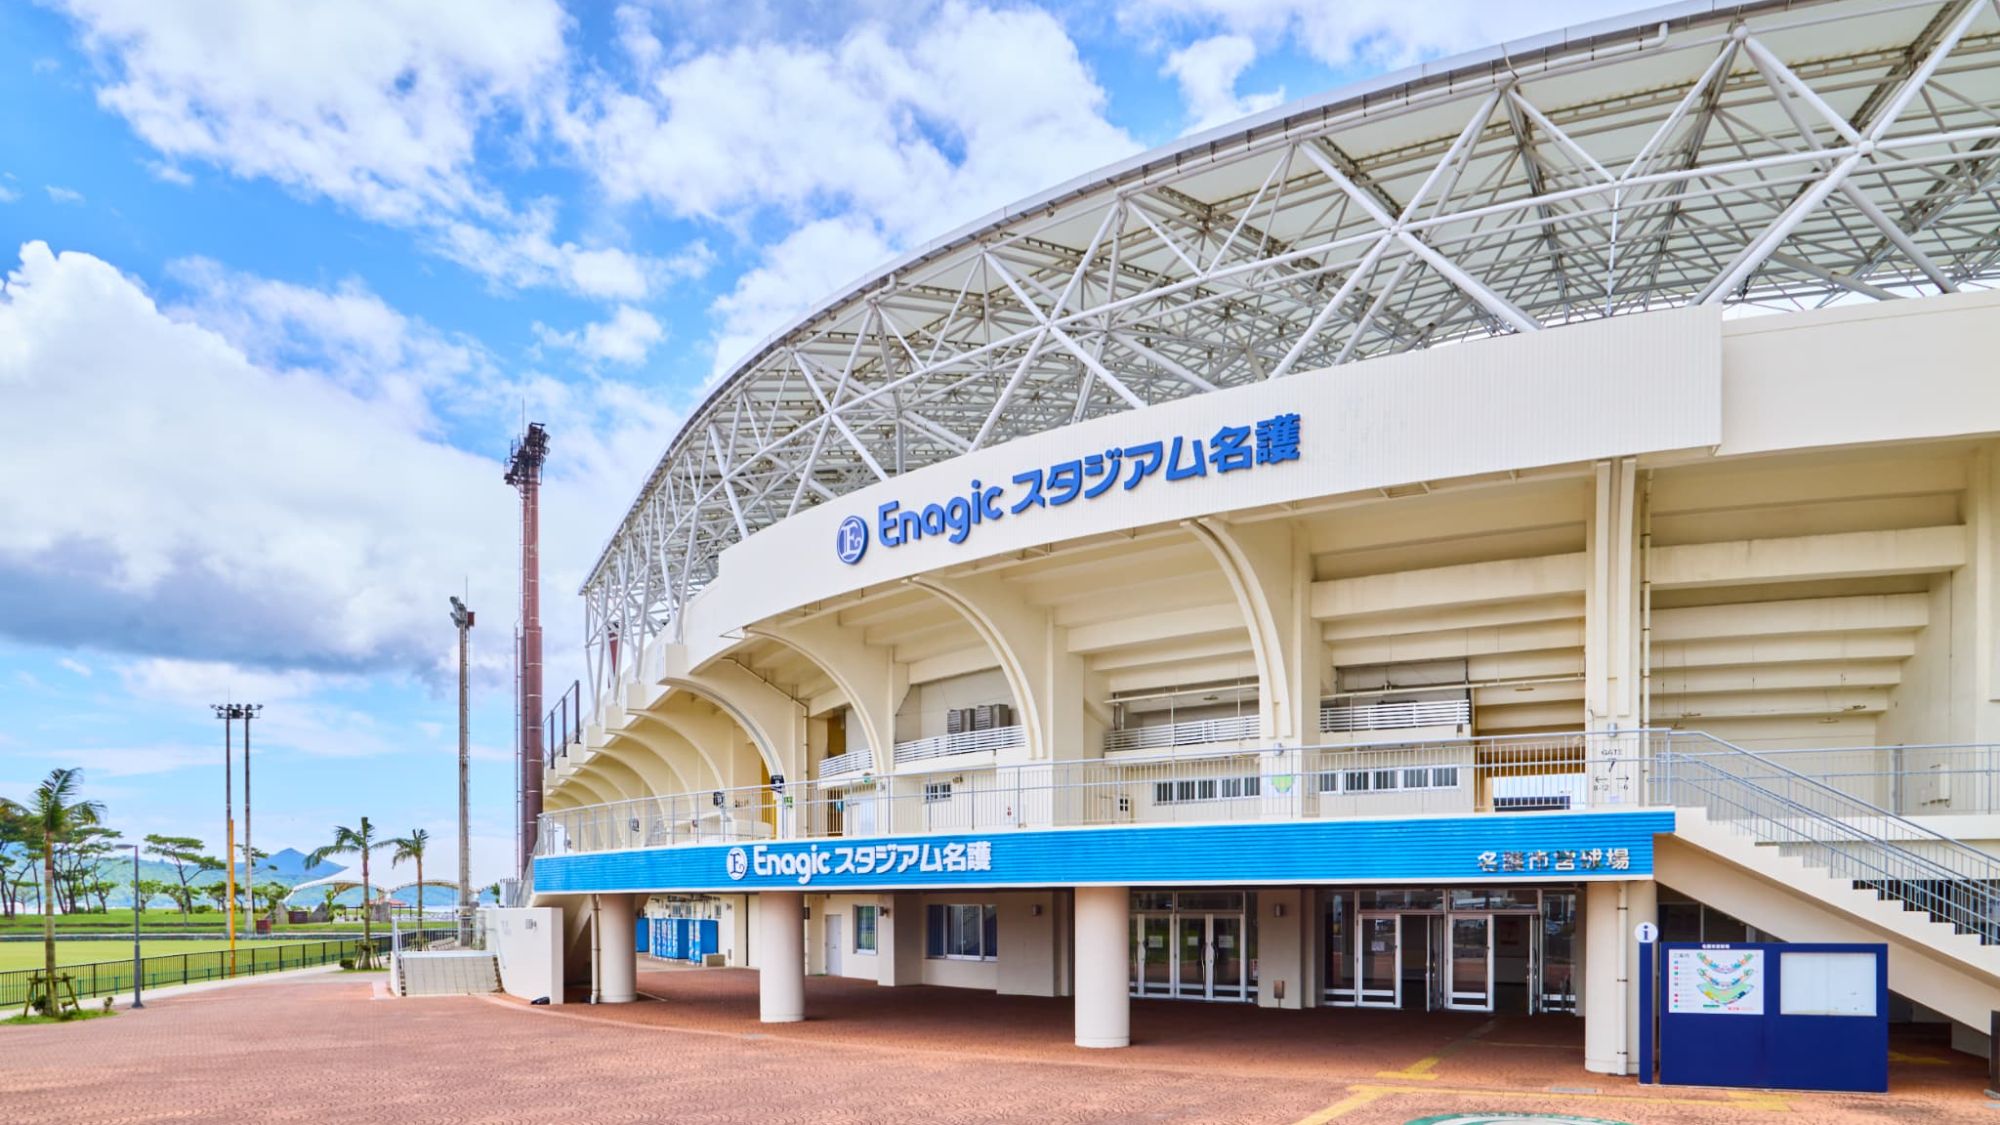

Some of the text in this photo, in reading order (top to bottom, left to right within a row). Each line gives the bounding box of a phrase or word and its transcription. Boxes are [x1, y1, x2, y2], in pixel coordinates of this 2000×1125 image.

[878, 480, 1005, 547] Enagic
[1011, 412, 1302, 514] スタジアム名護
[753, 845, 830, 884] Enagic
[834, 841, 992, 874] スタジアム名護
